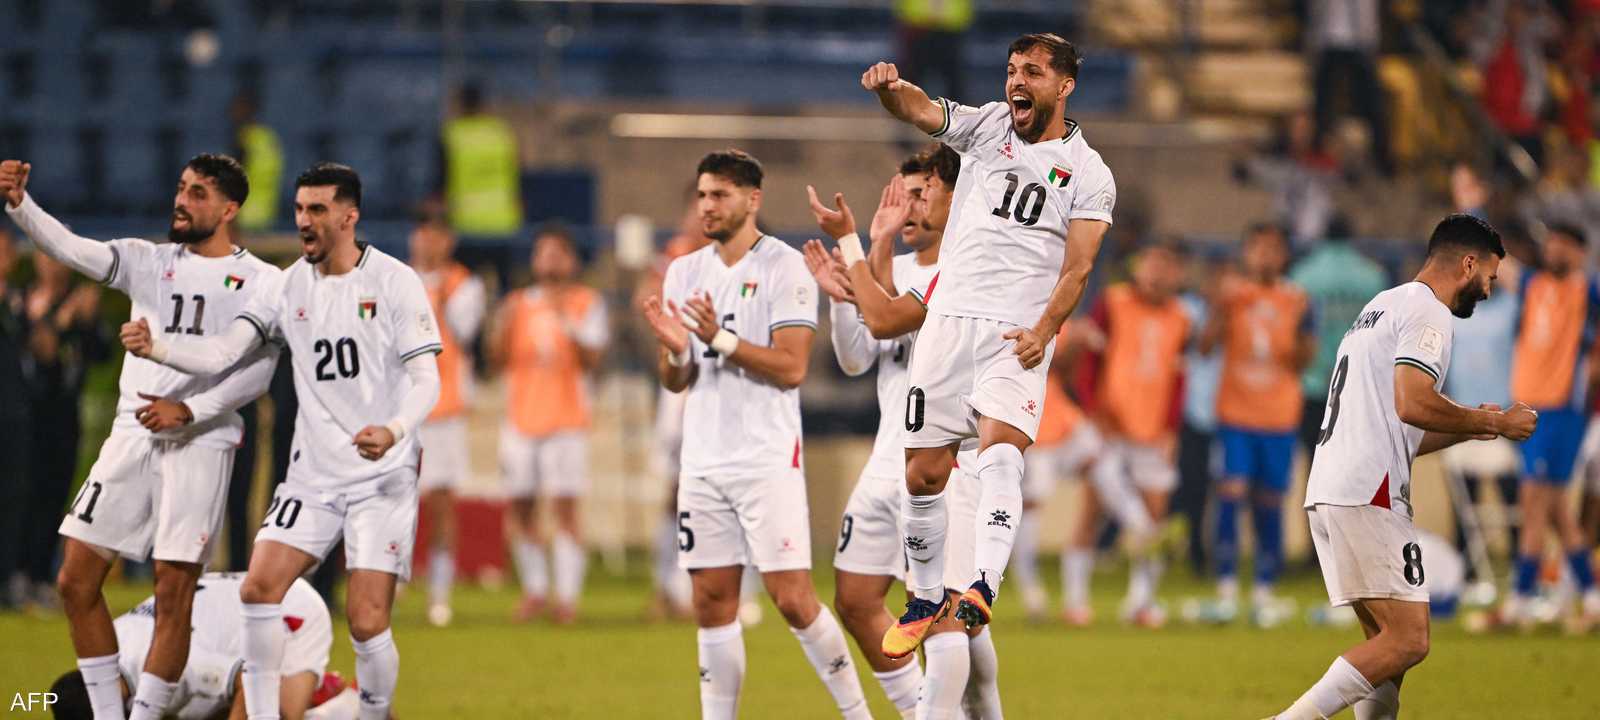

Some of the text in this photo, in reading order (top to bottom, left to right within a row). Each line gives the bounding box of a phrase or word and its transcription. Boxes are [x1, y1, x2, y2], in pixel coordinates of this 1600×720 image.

[992, 172, 1047, 226] 10
[164, 294, 205, 336] 11
[703, 313, 737, 358] 5
[314, 336, 360, 381] 20
[904, 386, 925, 432] 0
[262, 496, 303, 529] 20
[838, 513, 853, 553] 9
[987, 520, 1011, 530] KELME
[1402, 541, 1425, 587] 8
